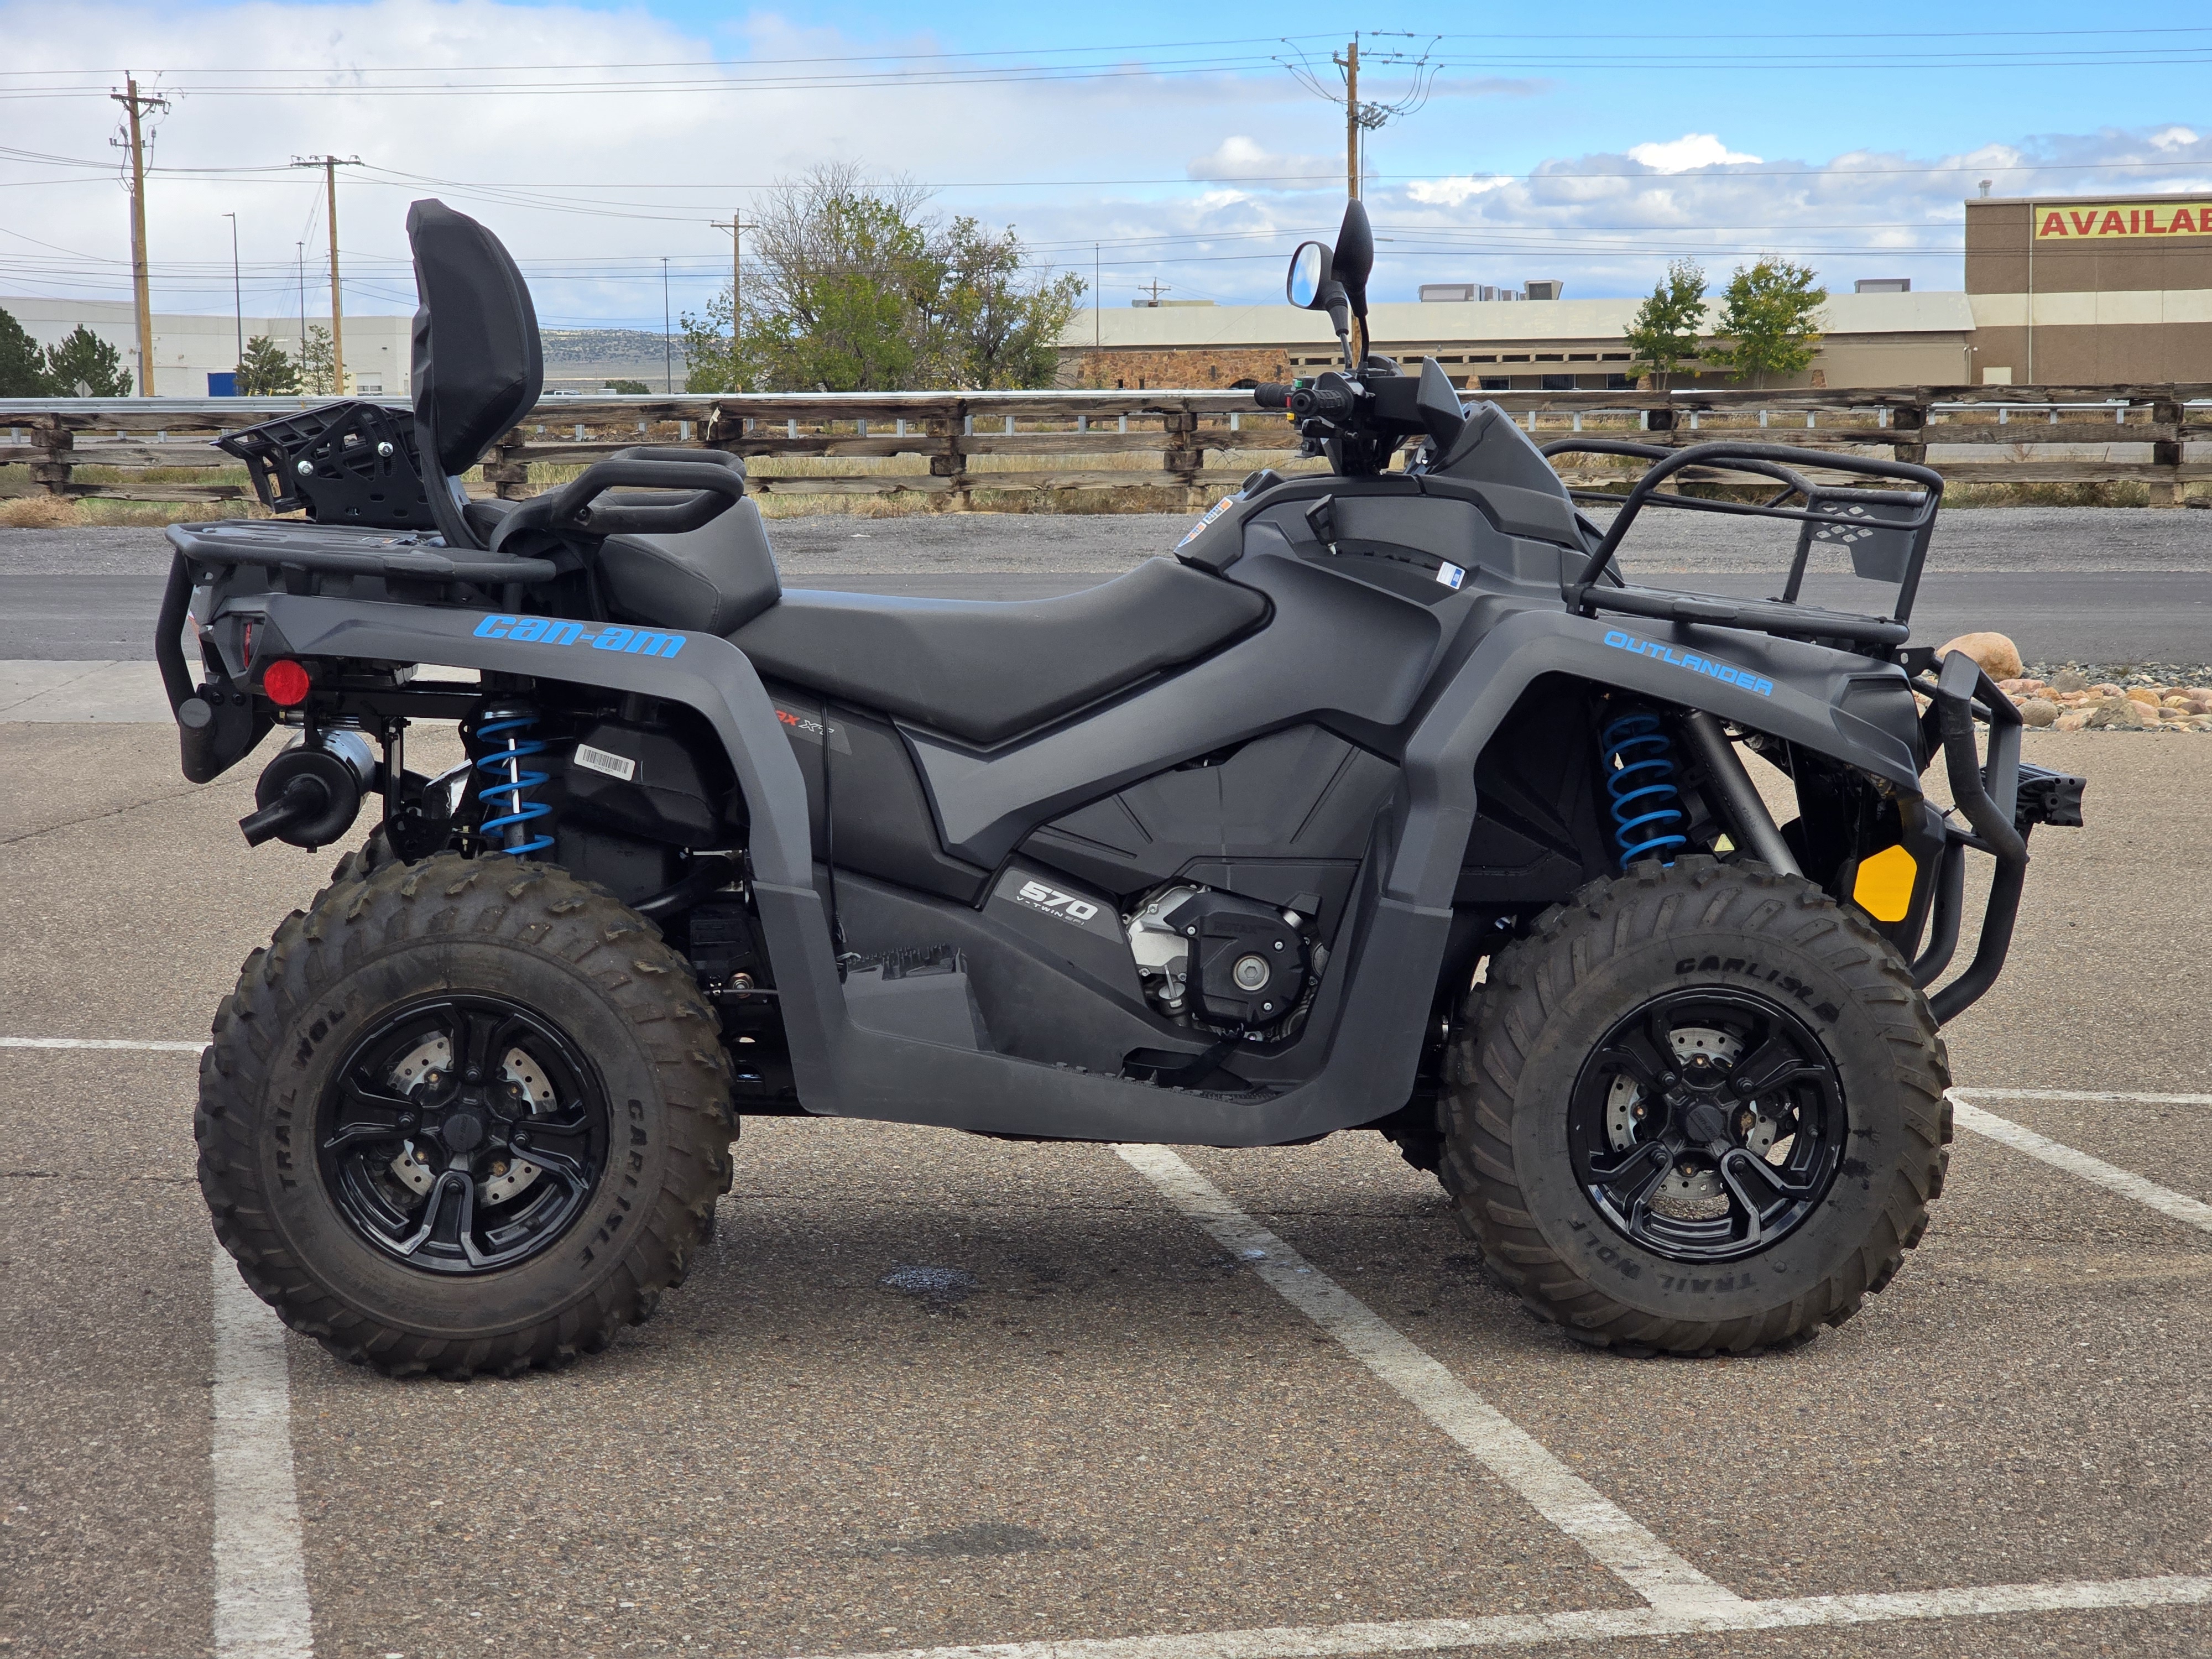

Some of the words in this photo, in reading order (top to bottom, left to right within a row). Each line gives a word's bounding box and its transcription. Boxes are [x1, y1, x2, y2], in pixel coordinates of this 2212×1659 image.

[473, 614, 686, 659] can-am
[1604, 630, 1773, 696] OUTLANDER
[1020, 881, 1098, 920] 570
[1674, 954, 1840, 1024] CARLISLE
[275, 1088, 299, 1193] TRAIL
[576, 1099, 649, 1270] CARLISLE
[1567, 1219, 1642, 1281] WOLF
[1660, 1272, 1757, 1294] TRAIL
